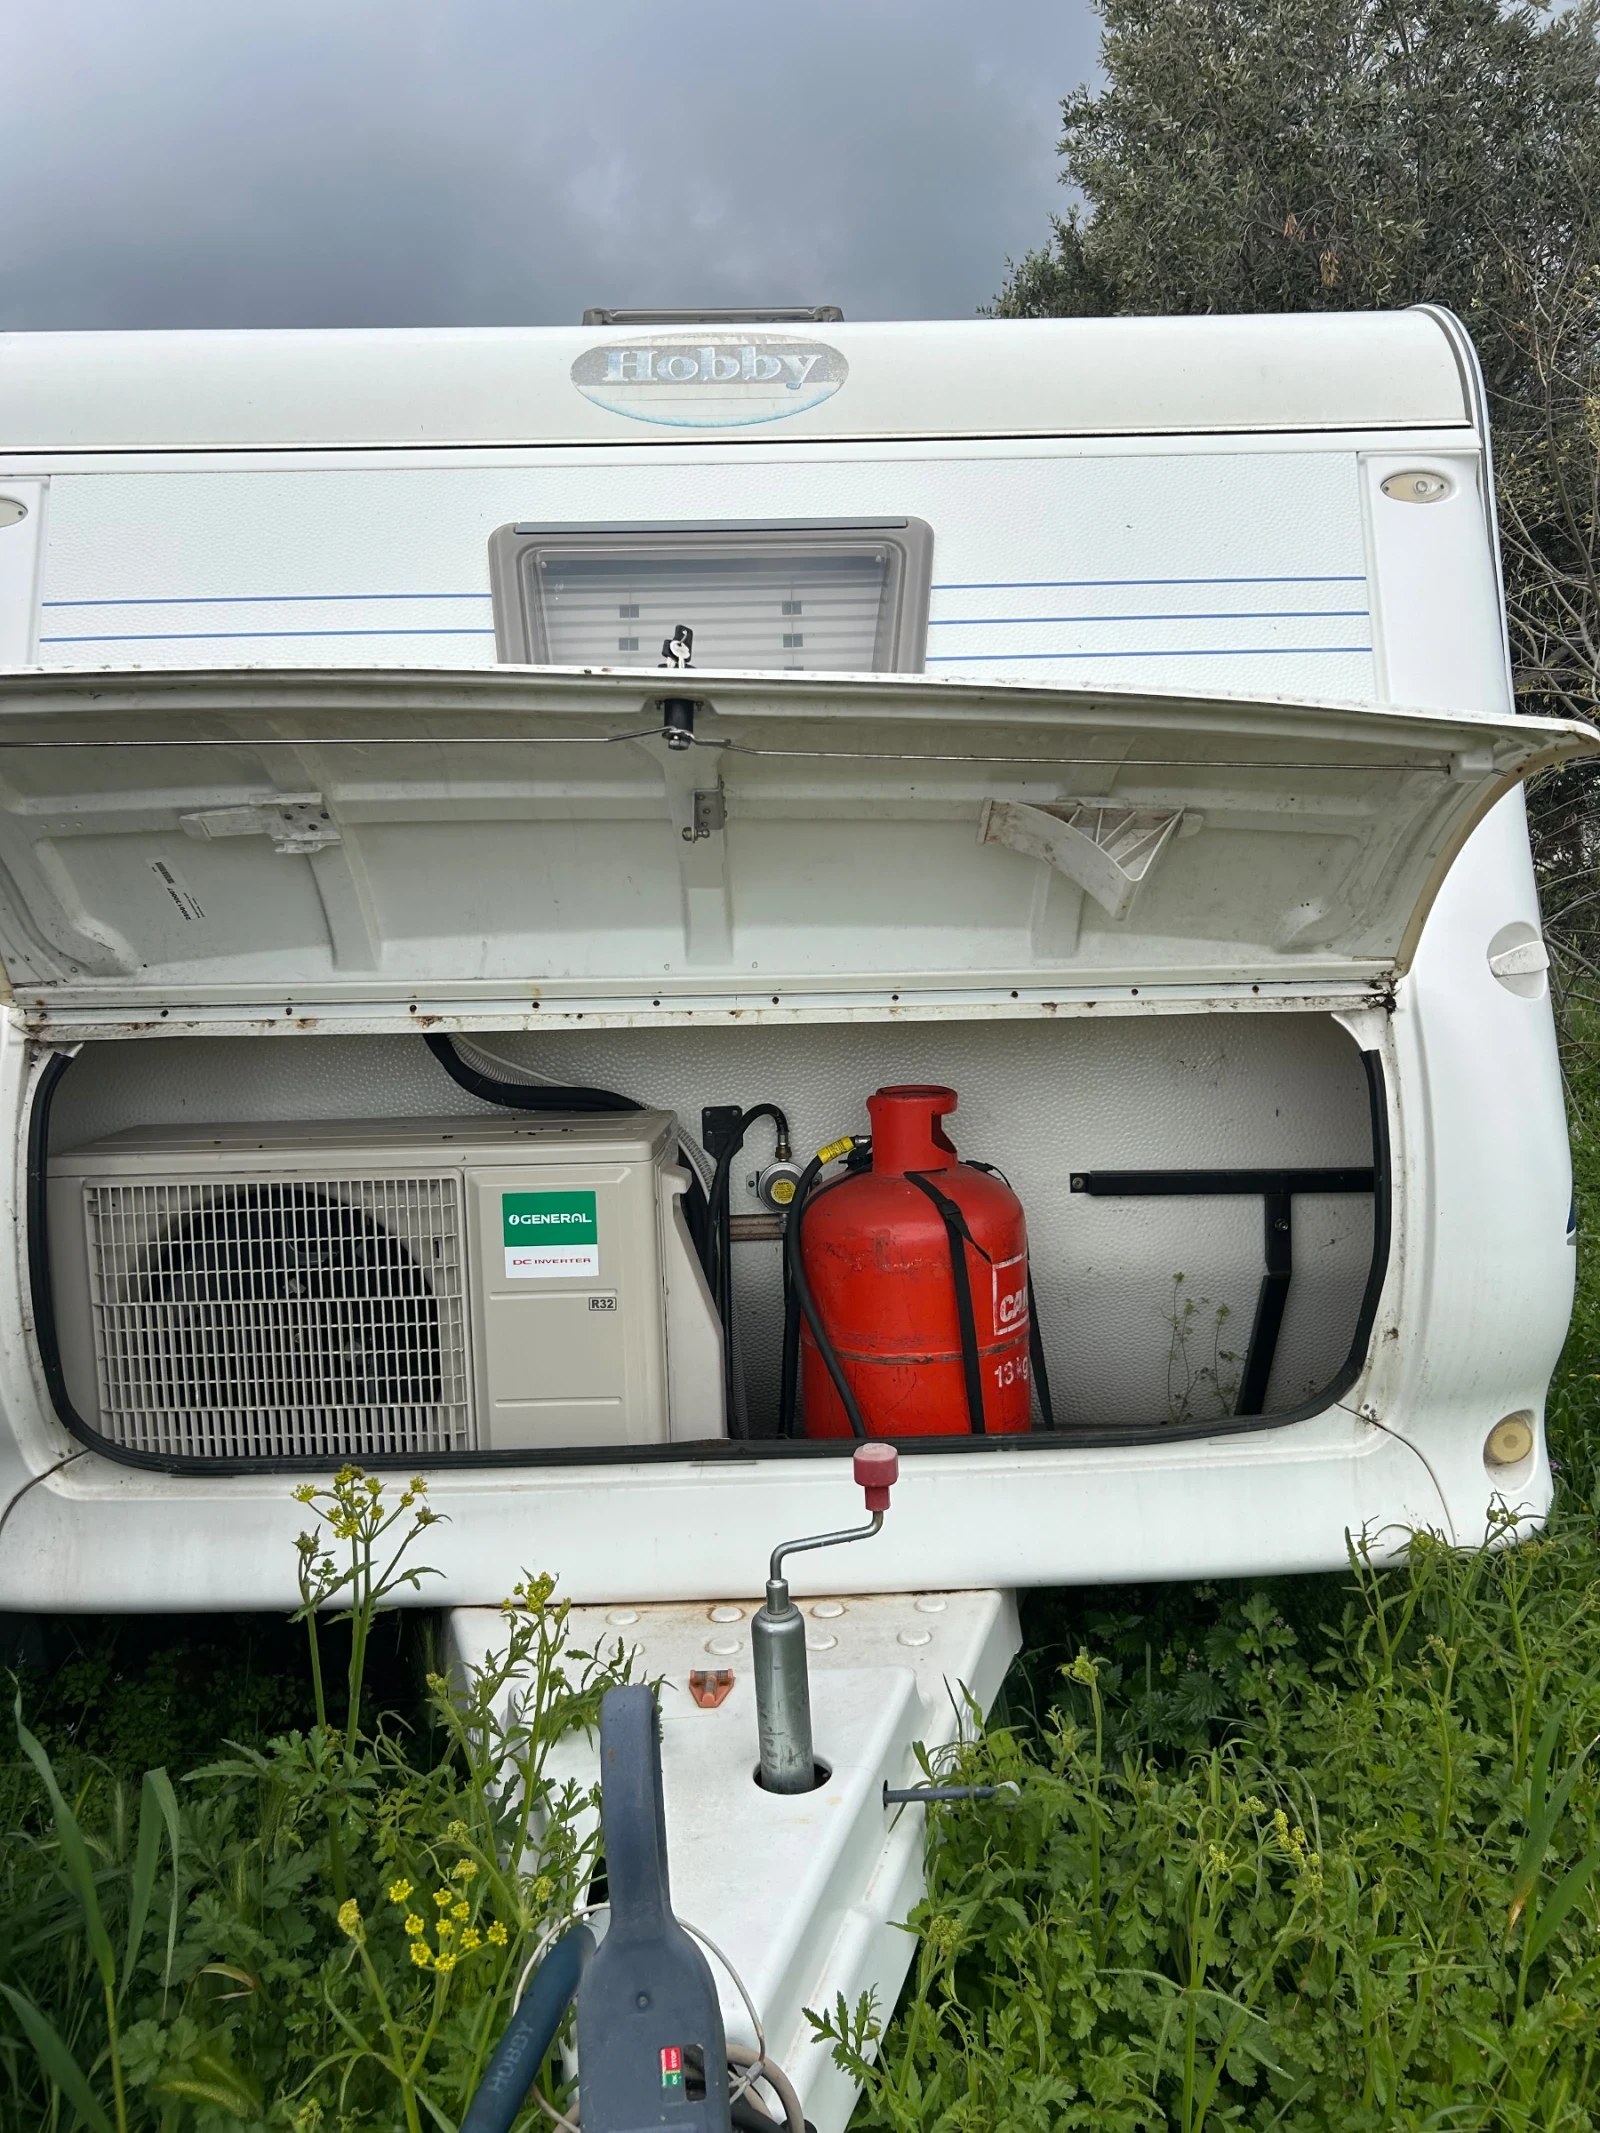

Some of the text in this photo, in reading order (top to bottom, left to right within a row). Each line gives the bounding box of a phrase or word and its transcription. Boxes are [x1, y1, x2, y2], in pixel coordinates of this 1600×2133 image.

[603, 346, 822, 390] Hobby
[520, 1213, 593, 1225] GENERAL
[591, 1299, 614, 1309] R32
[487, 2020, 534, 2094] HOBBY
[671, 2073, 678, 2085] OK
